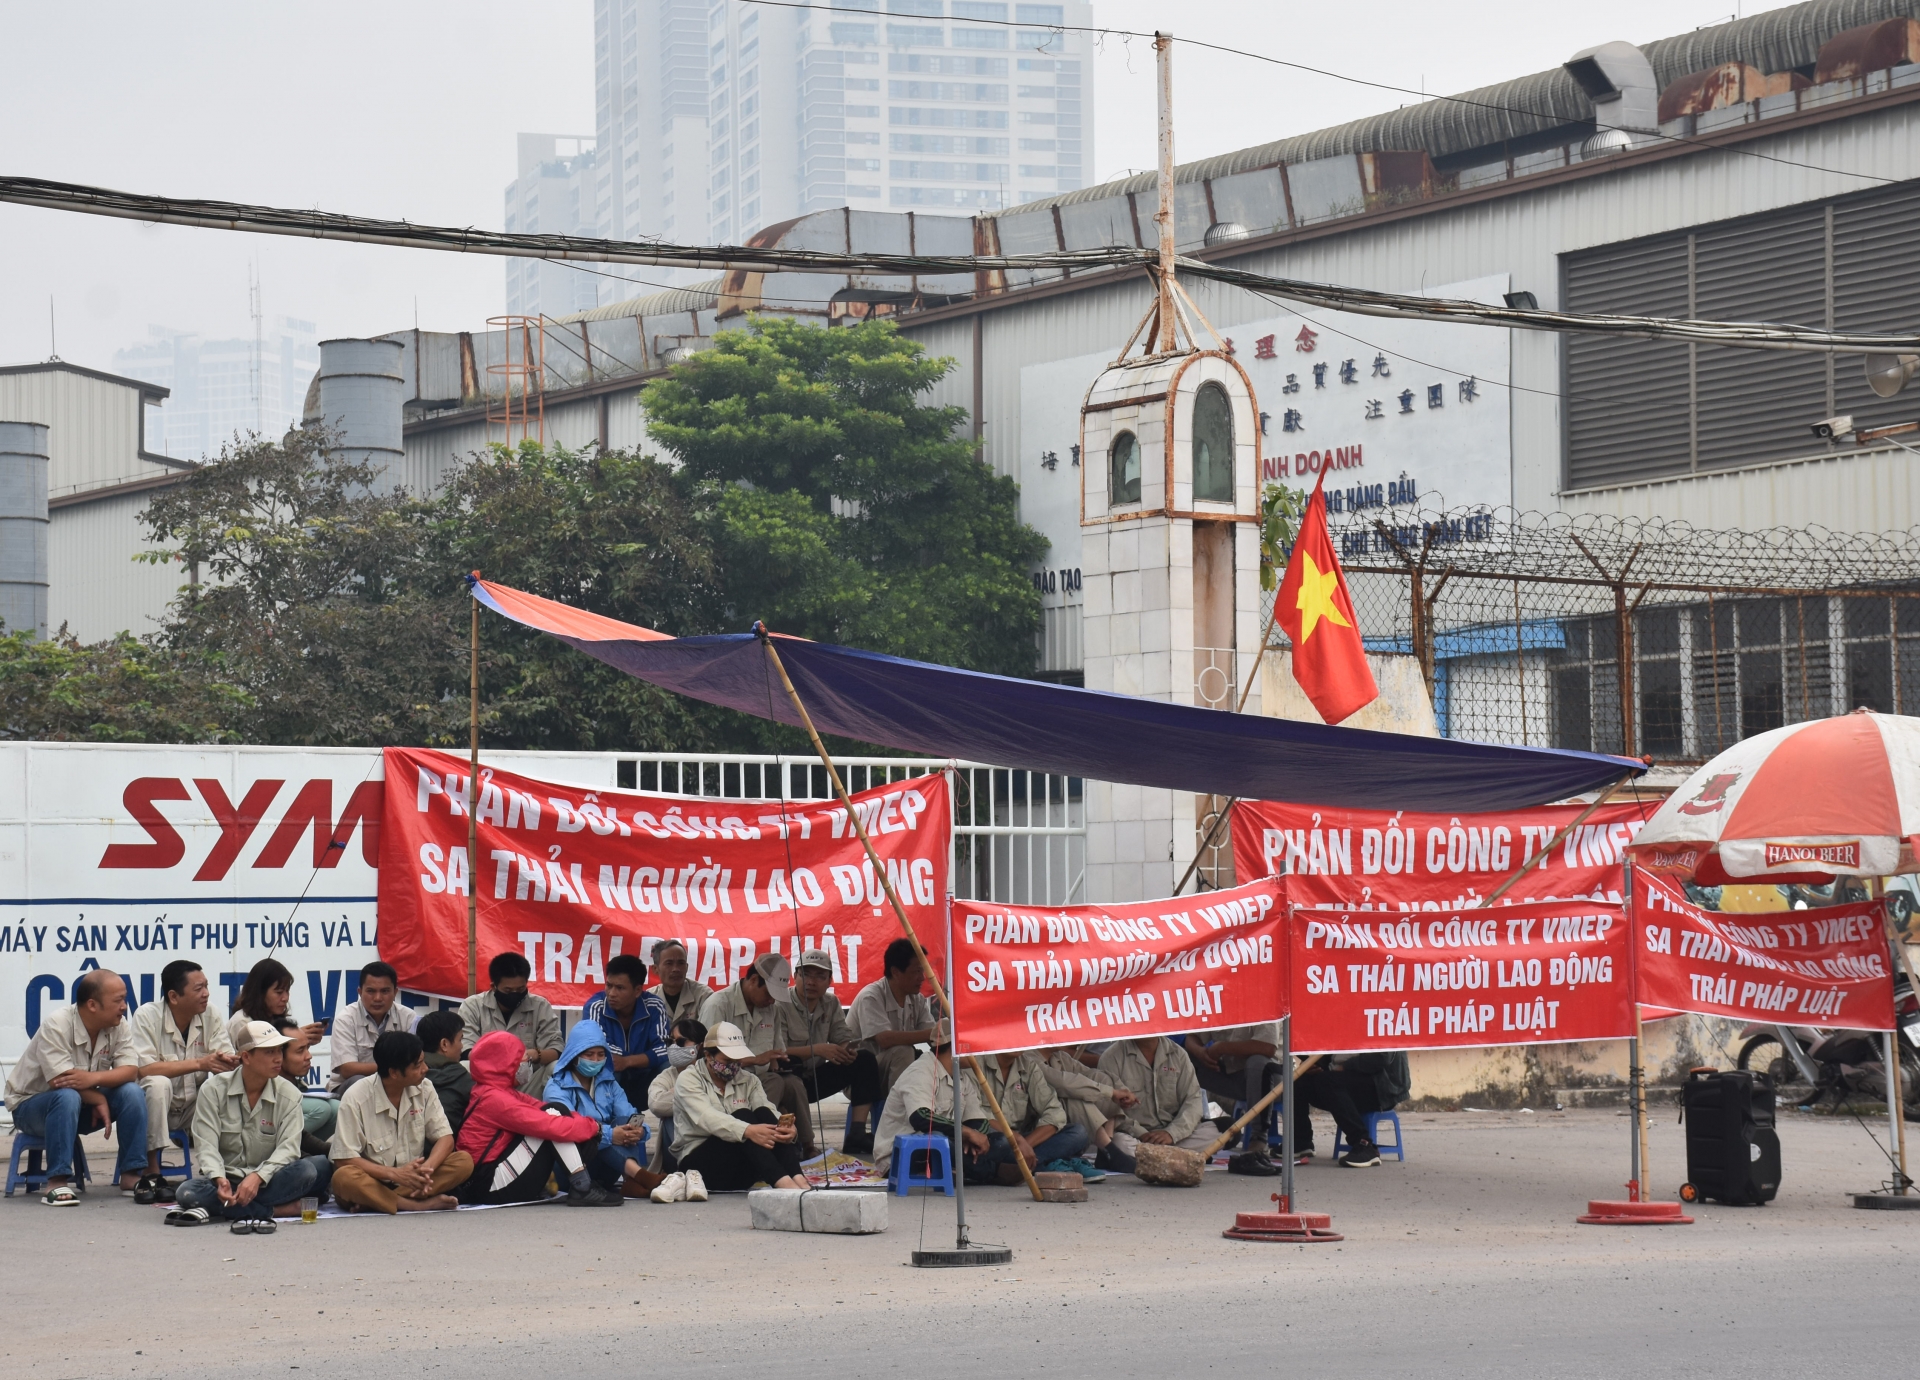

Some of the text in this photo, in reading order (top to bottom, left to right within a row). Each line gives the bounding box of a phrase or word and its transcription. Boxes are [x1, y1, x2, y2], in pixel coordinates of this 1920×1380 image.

[1282, 352, 1390, 394] 品質優先
[1364, 375, 1480, 420] 注重團隊
[1263, 444, 1363, 480] NH DOANH
[1346, 480, 1384, 512] HÀNG
[1060, 558, 1082, 596] TẠO
[417, 765, 541, 830] PHẢN
[817, 790, 926, 839] VMEP
[98, 777, 386, 881] SYM
[1263, 812, 1352, 876] PHẢN
[1362, 811, 1415, 874] ĐỐI
[1426, 817, 1510, 874] CÔNG
[1521, 826, 1556, 869] TY
[1769, 845, 1855, 865] HANOI BEER
[419, 843, 934, 916] SA THẢI NGƯỜI LAO ĐỘNG
[56, 914, 107, 952] SẢN
[114, 914, 183, 951] XUẤT
[191, 922, 238, 954] PHỤ
[245, 915, 309, 948] TÙNG
[321, 915, 353, 948] VÀ
[361, 914, 379, 946] L
[965, 908, 1040, 944] PHẢN
[1047, 911, 1089, 944] ĐỐI
[1094, 917, 1163, 943] CÔNG
[1163, 911, 1197, 936] TY
[1197, 894, 1273, 928] VMEP
[1305, 913, 1613, 949] PHẢN ĐỐI CÔNG TY VMEP
[1718, 921, 1778, 949] CÔNG
[1778, 923, 1808, 946] TY
[1812, 915, 1874, 945] VMEP
[518, 925, 622, 984] TRÁI
[967, 961, 1005, 992] SA
[1012, 950, 1072, 990] THẢI
[1080, 949, 1154, 987] NGƯỜI
[1203, 935, 1273, 974] ĐỘNG
[1306, 953, 1612, 994] SA THẢI NGƯỜI LAO ĐỘNG
[1645, 925, 1671, 954] SA
[1794, 960, 1828, 979] AO
[1822, 953, 1887, 982] ĐỘNG
[1025, 980, 1224, 1034] TRÁI PHÁP LUẬT
[1365, 997, 1560, 1036] TRÁI PHÁP LUẬT
[1690, 973, 1848, 1020] TRÁI PHÁP LUẬT
